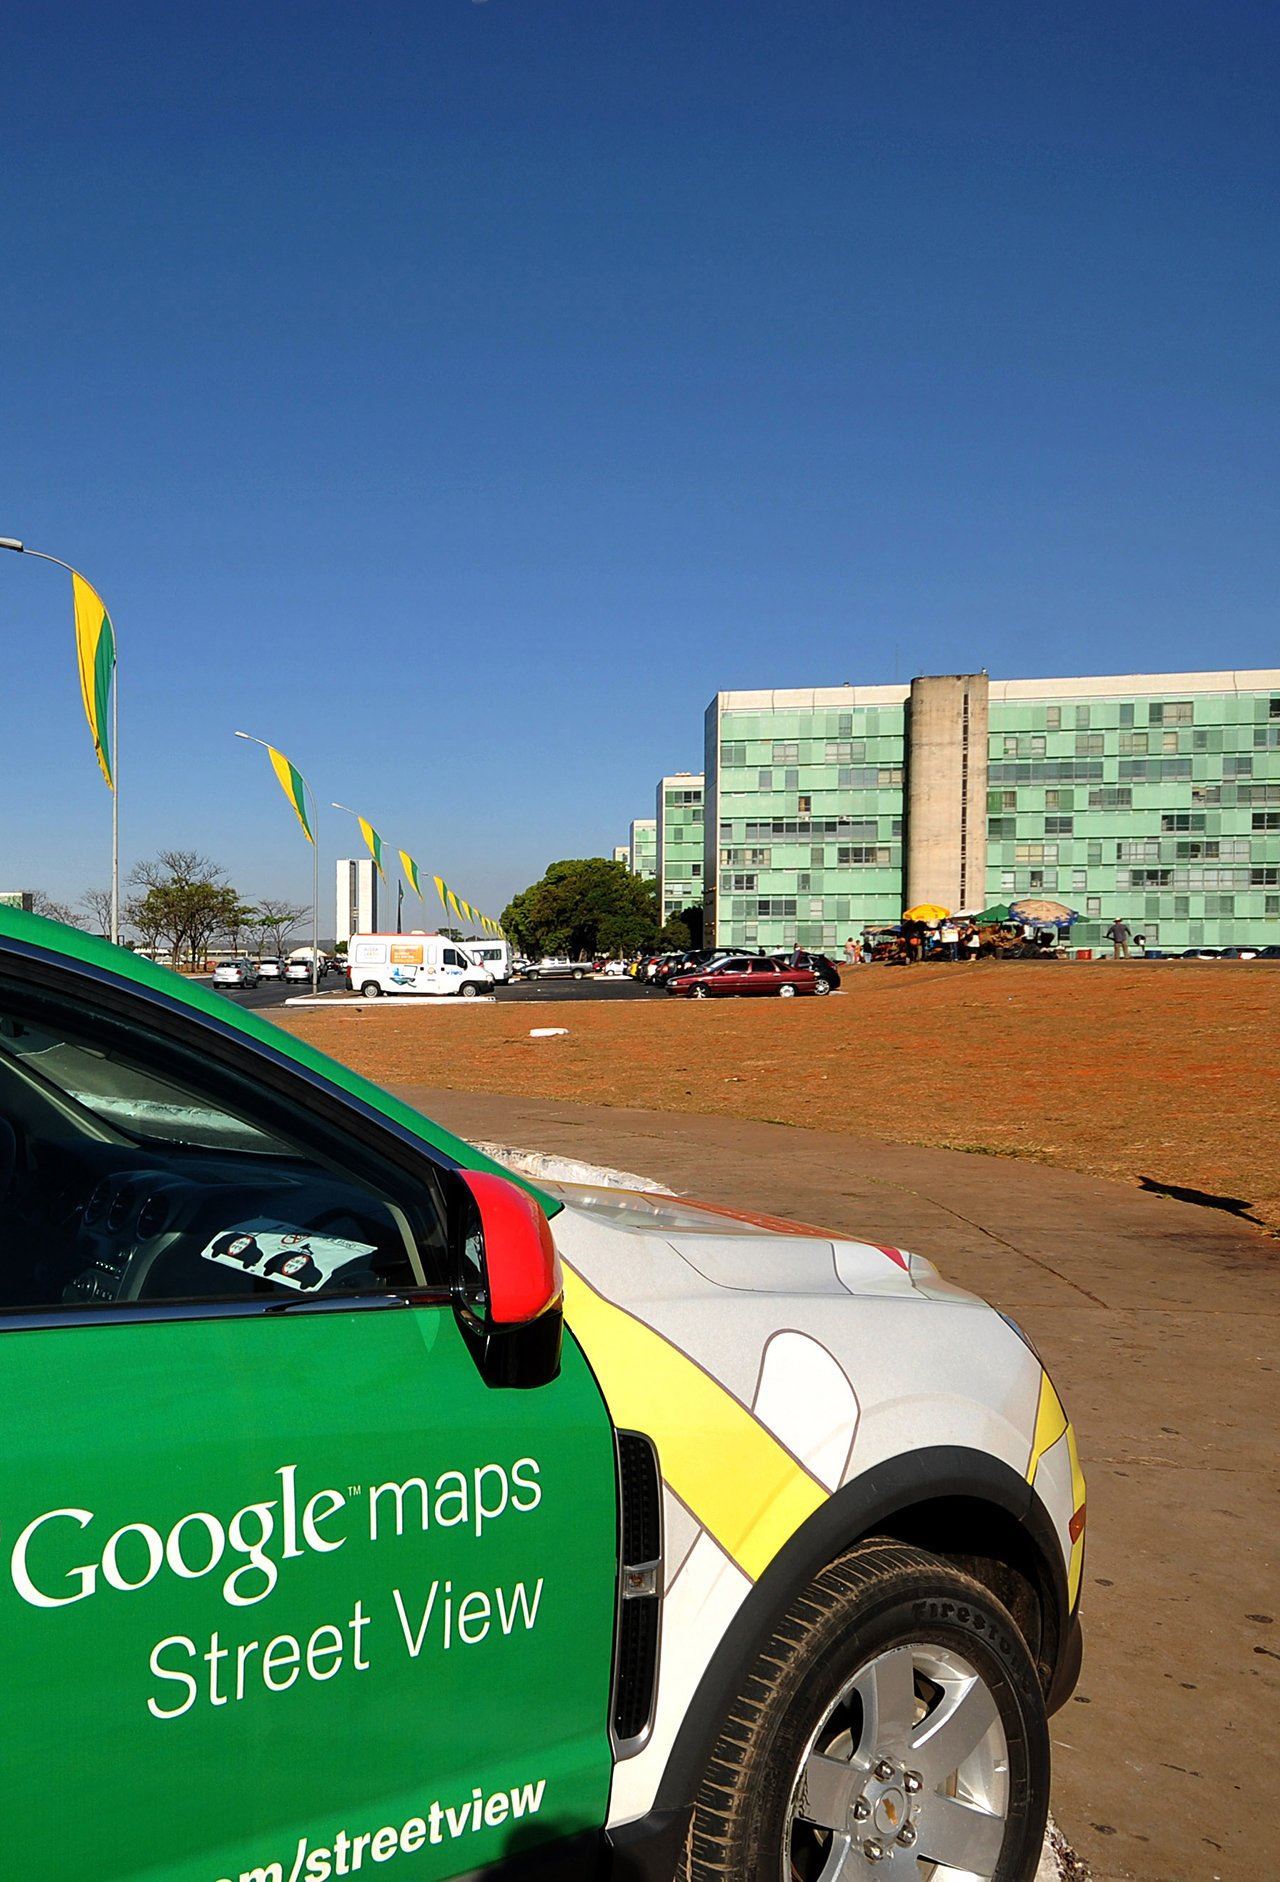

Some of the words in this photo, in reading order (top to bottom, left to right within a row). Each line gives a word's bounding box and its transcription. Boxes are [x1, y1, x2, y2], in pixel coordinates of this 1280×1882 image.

[10, 1464, 347, 1608] Google
[369, 1457, 543, 1541] maps
[146, 1600, 371, 1719] Street
[392, 1578, 545, 1658] View
[911, 1600, 1022, 1670] Firesto
[216, 1779, 546, 1882] m/streetview
